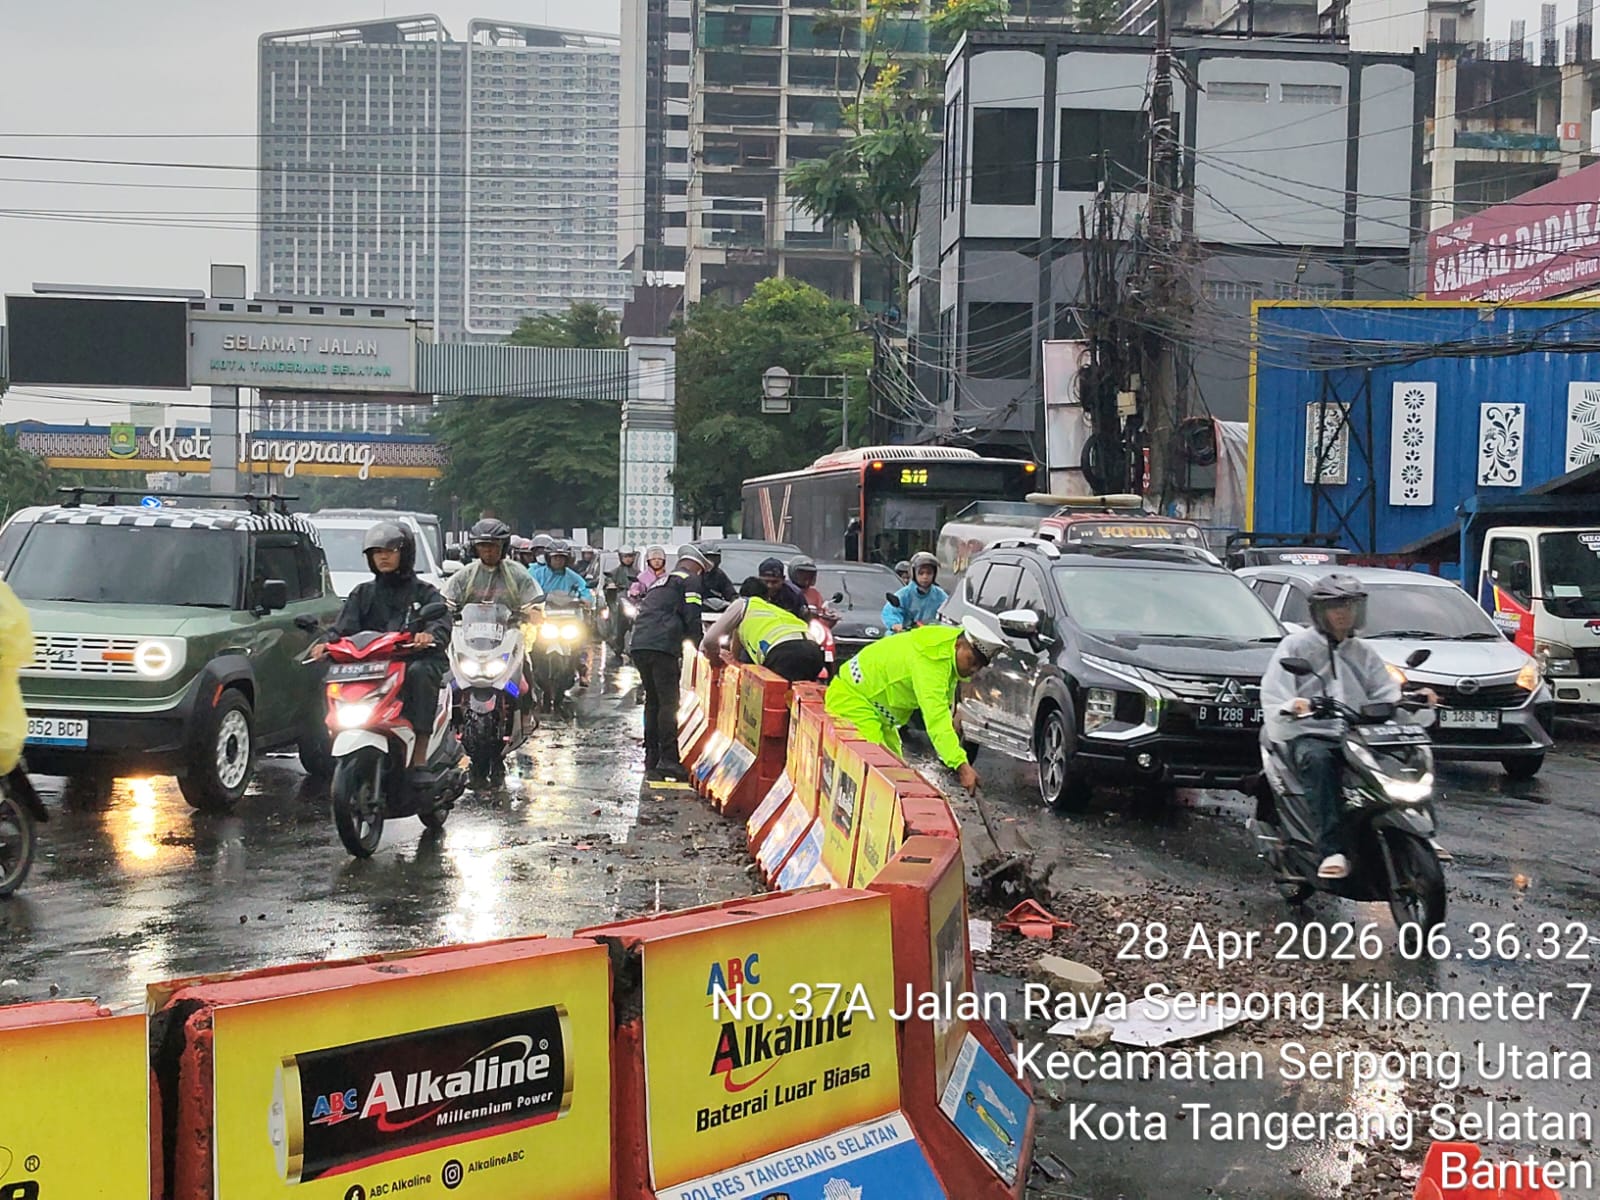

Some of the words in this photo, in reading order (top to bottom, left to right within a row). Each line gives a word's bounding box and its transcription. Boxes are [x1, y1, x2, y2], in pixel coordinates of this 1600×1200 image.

[1434, 232, 1511, 295] SAMBAL
[1544, 264, 1573, 287] Sampai
[1575, 258, 1598, 277] Perut
[223, 334, 312, 352] SELAMAT
[319, 337, 378, 357] JALAN
[210, 359, 246, 372] KOTA
[250, 360, 328, 375] TANGERANG
[332, 364, 392, 377] SELATAN
[58, 721, 83, 737] BCP
[1200, 706, 1207, 720] B
[1218, 707, 1244, 721] 1288
[706, 953, 760, 996] ABC
[709, 1010, 854, 1077] Alkaline
[311, 1088, 358, 1119] ABC
[359, 1053, 551, 1120] Alkaline
[695, 1088, 768, 1132] Baterai
[775, 1080, 818, 1110] Luar
[823, 1061, 872, 1092] Biasa
[436, 1098, 512, 1127] Millennium
[517, 1090, 553, 1108] Power
[467, 1150, 525, 1174] AlkalineABC
[747, 1146, 837, 1189] TANGERANG
[838, 1124, 899, 1157] SELATAN
[369, 1183, 389, 1199] ABC
[391, 1173, 431, 1193] Alkaline
